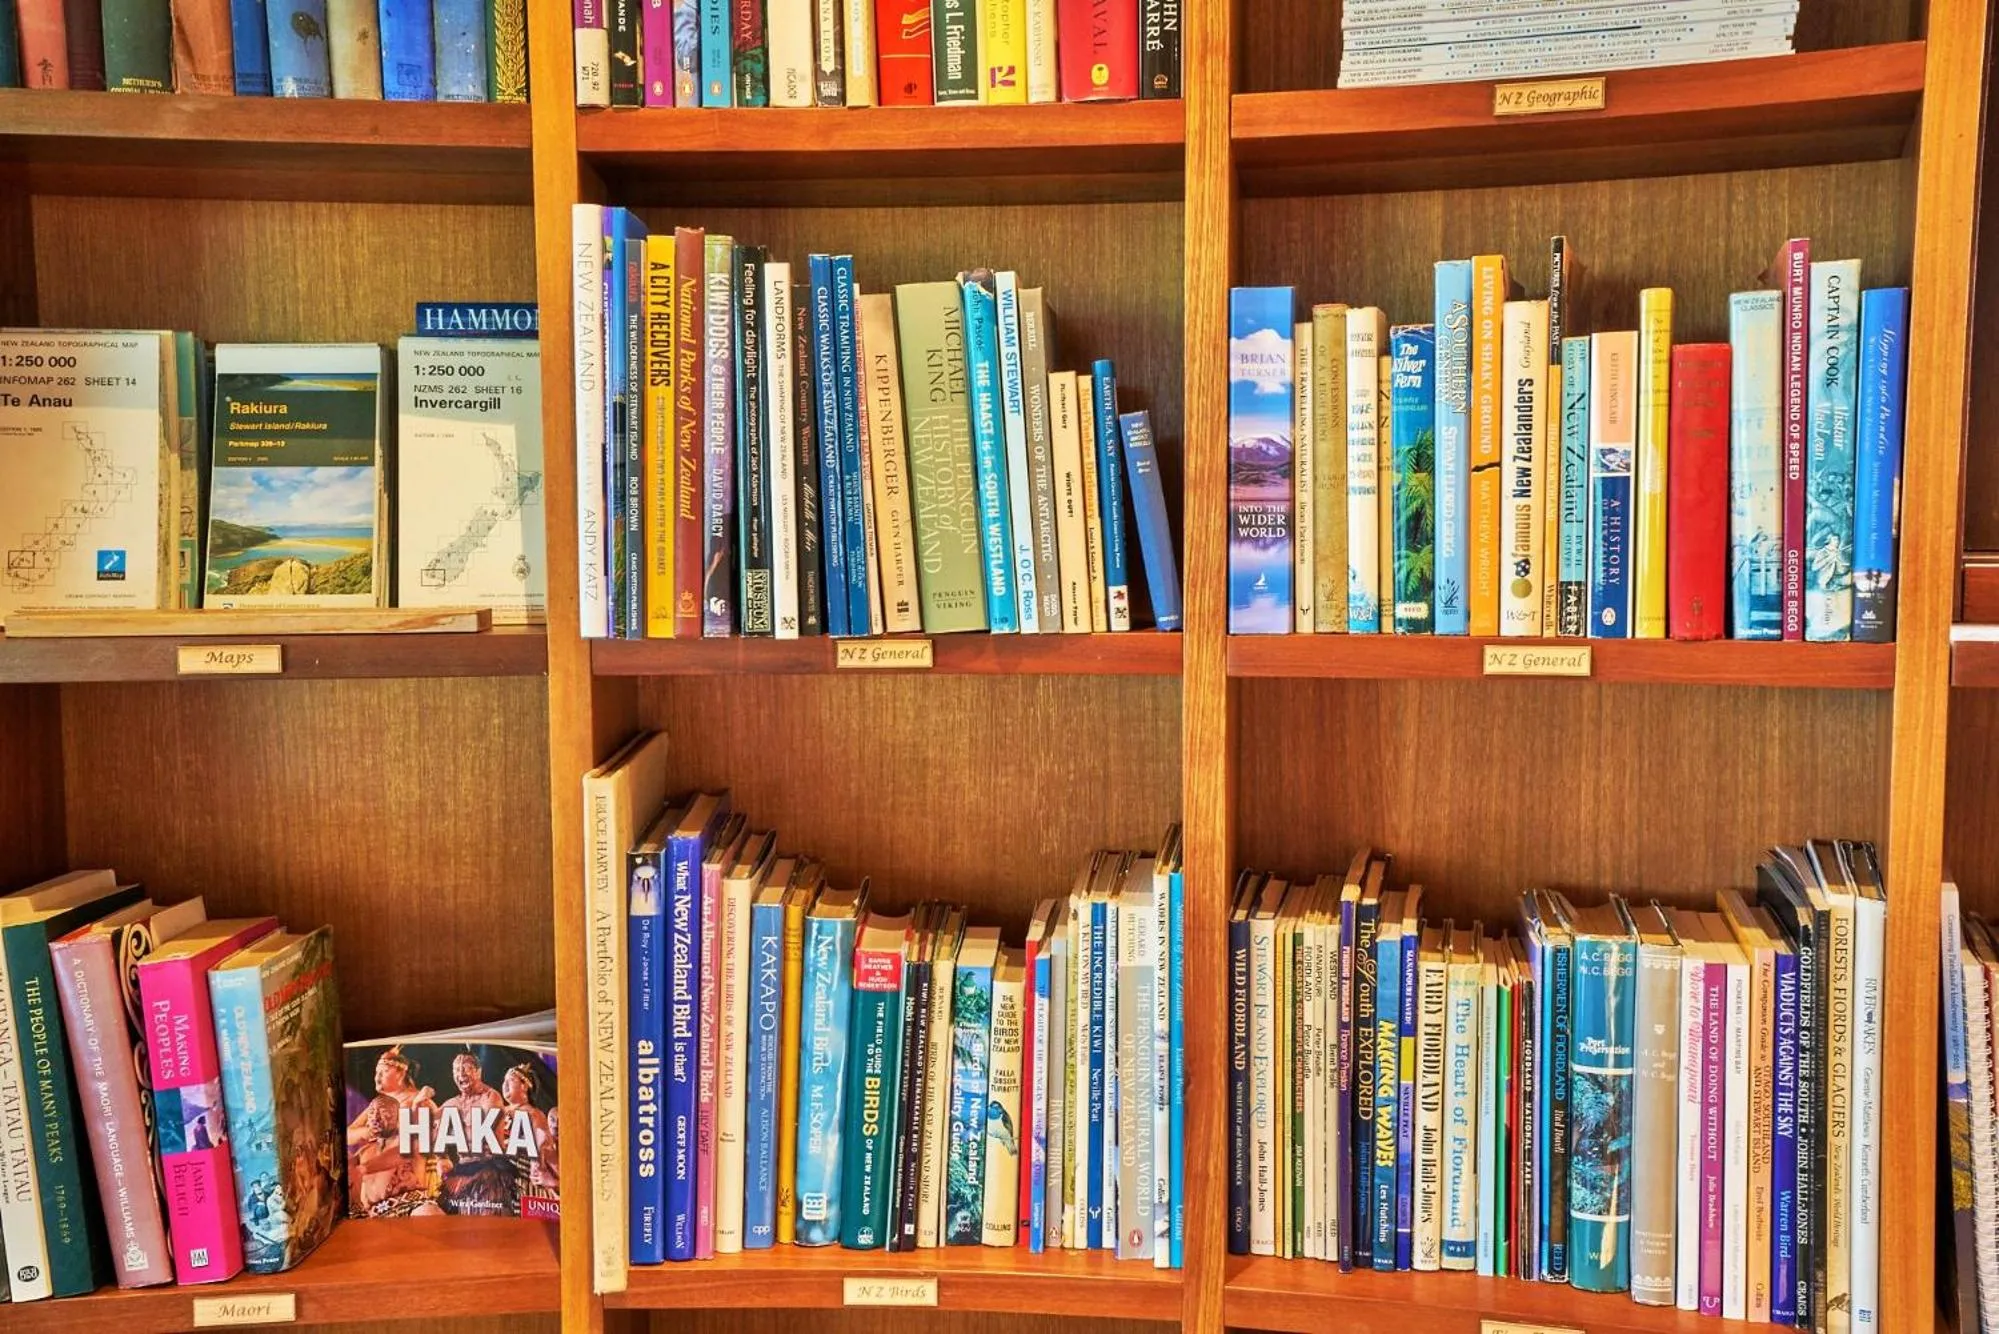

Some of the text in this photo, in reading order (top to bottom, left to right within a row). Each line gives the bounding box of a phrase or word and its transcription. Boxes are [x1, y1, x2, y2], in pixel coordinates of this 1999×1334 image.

[822, 30, 831, 63] LEON
[944, 25, 964, 80] Friedman
[1526, 87, 1600, 109] Geographic
[708, 272, 730, 311] KIWI
[773, 280, 786, 360] LANDFORMS
[57, 341, 120, 349] TOPOGRAPHICAL
[122, 341, 139, 349] MAP
[650, 261, 671, 387] A CITY RECOVERS
[708, 314, 730, 360] DOGS
[743, 263, 758, 378] Feeling for daylight
[1826, 275, 1841, 388] CAPTAIN COOK
[48, 355, 77, 369] 000
[458, 365, 485, 377] 000
[926, 348, 947, 403] KING
[942, 306, 966, 403] MICHAEL
[1001, 288, 1020, 416] WILLIAM STEWART
[2, 394, 73, 409] Te Anau
[56, 376, 77, 387] 262
[84, 376, 120, 388] SHEET
[124, 376, 138, 387] 14
[229, 401, 288, 415] Rakiura
[413, 396, 501, 412] Invercargill
[414, 384, 523, 395] NZMS 262 SHEET 16
[677, 274, 697, 521] National Parks of New Zealand
[711, 377, 726, 409] THEIR
[228, 421, 262, 431] Stewart
[578, 243, 599, 602] NEW ZEALAND ANDY KATZ
[629, 314, 640, 531] THE WILDERNESS OF STEWART ISLAND ROB BROWN
[711, 412, 725, 454] PEOPLE
[874, 354, 900, 497] KIPPENBERGER
[1787, 252, 1804, 632] BURT MUNRO INDIAN LEGEND OF SPEED GEORGE BEGG
[712, 468, 724, 500] DAVID
[1511, 378, 1534, 559] famous New Zealanders
[712, 504, 724, 537] DARCY
[1238, 514, 1287, 526] WIDER
[1238, 527, 1287, 538] WORLD
[1266, 505, 1287, 513] THE
[1608, 499, 1621, 586] A HISTORY
[753, 571, 767, 630] MUSEUM
[205, 651, 254, 665] Maps
[872, 646, 927, 662] General
[1523, 651, 1585, 669] General
[759, 936, 778, 1031] KAKAPO
[1092, 923, 1104, 1054] THE INCREDIBLE KIWI
[1234, 948, 1247, 1070] WILD FIORDLAND
[152, 1000, 175, 1080] PEOPLES
[173, 1014, 192, 1077] MAKING
[672, 859, 693, 1181] What New Zealand Bird is that? GEOFF MOON
[1356, 918, 1377, 1120] The South EXPLORED
[1831, 917, 1849, 1138] FORESTS, FIORDS & GLACIERS
[25, 977, 64, 1164] THE PEOPLE OF MANY PEAKS
[1707, 985, 1719, 1162] THE LAND OF DOING WITHOUT
[399, 1106, 538, 1157] HAKA
[638, 1039, 660, 1178] albatross
[1376, 1020, 1397, 1243] MAKING WAVES Les Hutchins
[1778, 972, 1796, 1258] VIADUCTS AGAINST THE SKY Warren Bird
[862, 1077, 881, 1215] BIRDS OF NEW ZEALAND
[1257, 1139, 1268, 1212] John Hall-Jones
[643, 1206, 654, 1245] FIREFLY
[218, 1302, 272, 1319] Maori
[888, 1283, 927, 1300] Birds
